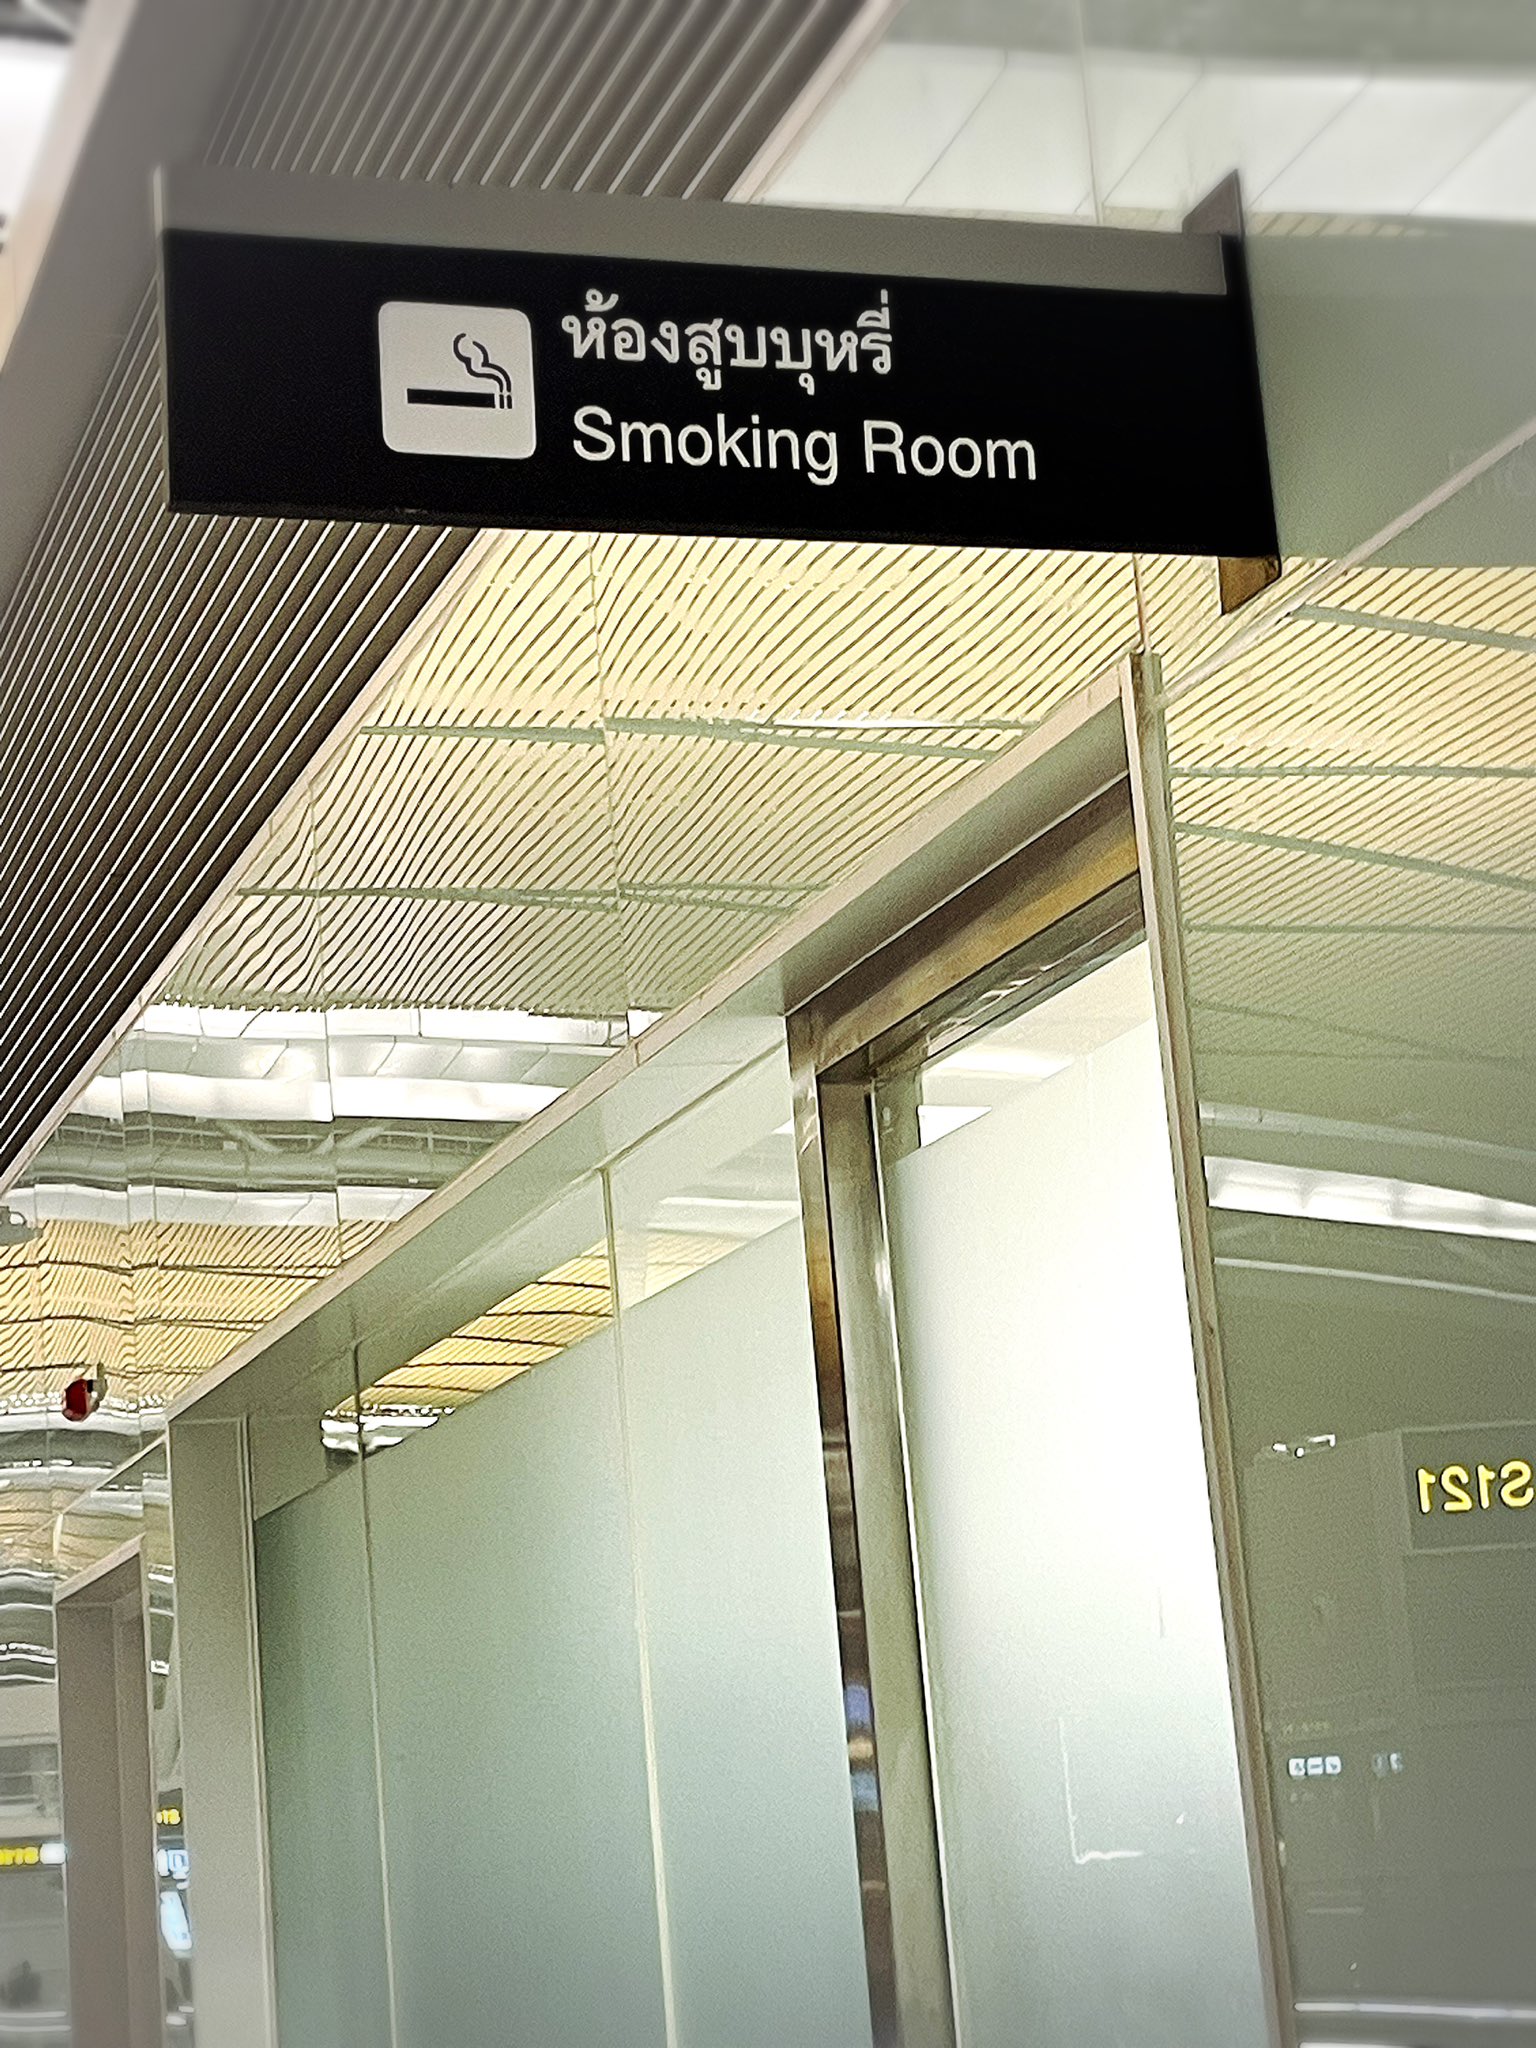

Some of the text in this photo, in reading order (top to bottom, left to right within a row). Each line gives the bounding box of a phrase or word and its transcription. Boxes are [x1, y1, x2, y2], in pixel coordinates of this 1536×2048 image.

[561, 288, 893, 396] ห้องสูบบุหรี่
[573, 405, 1038, 486] Smoking Room
